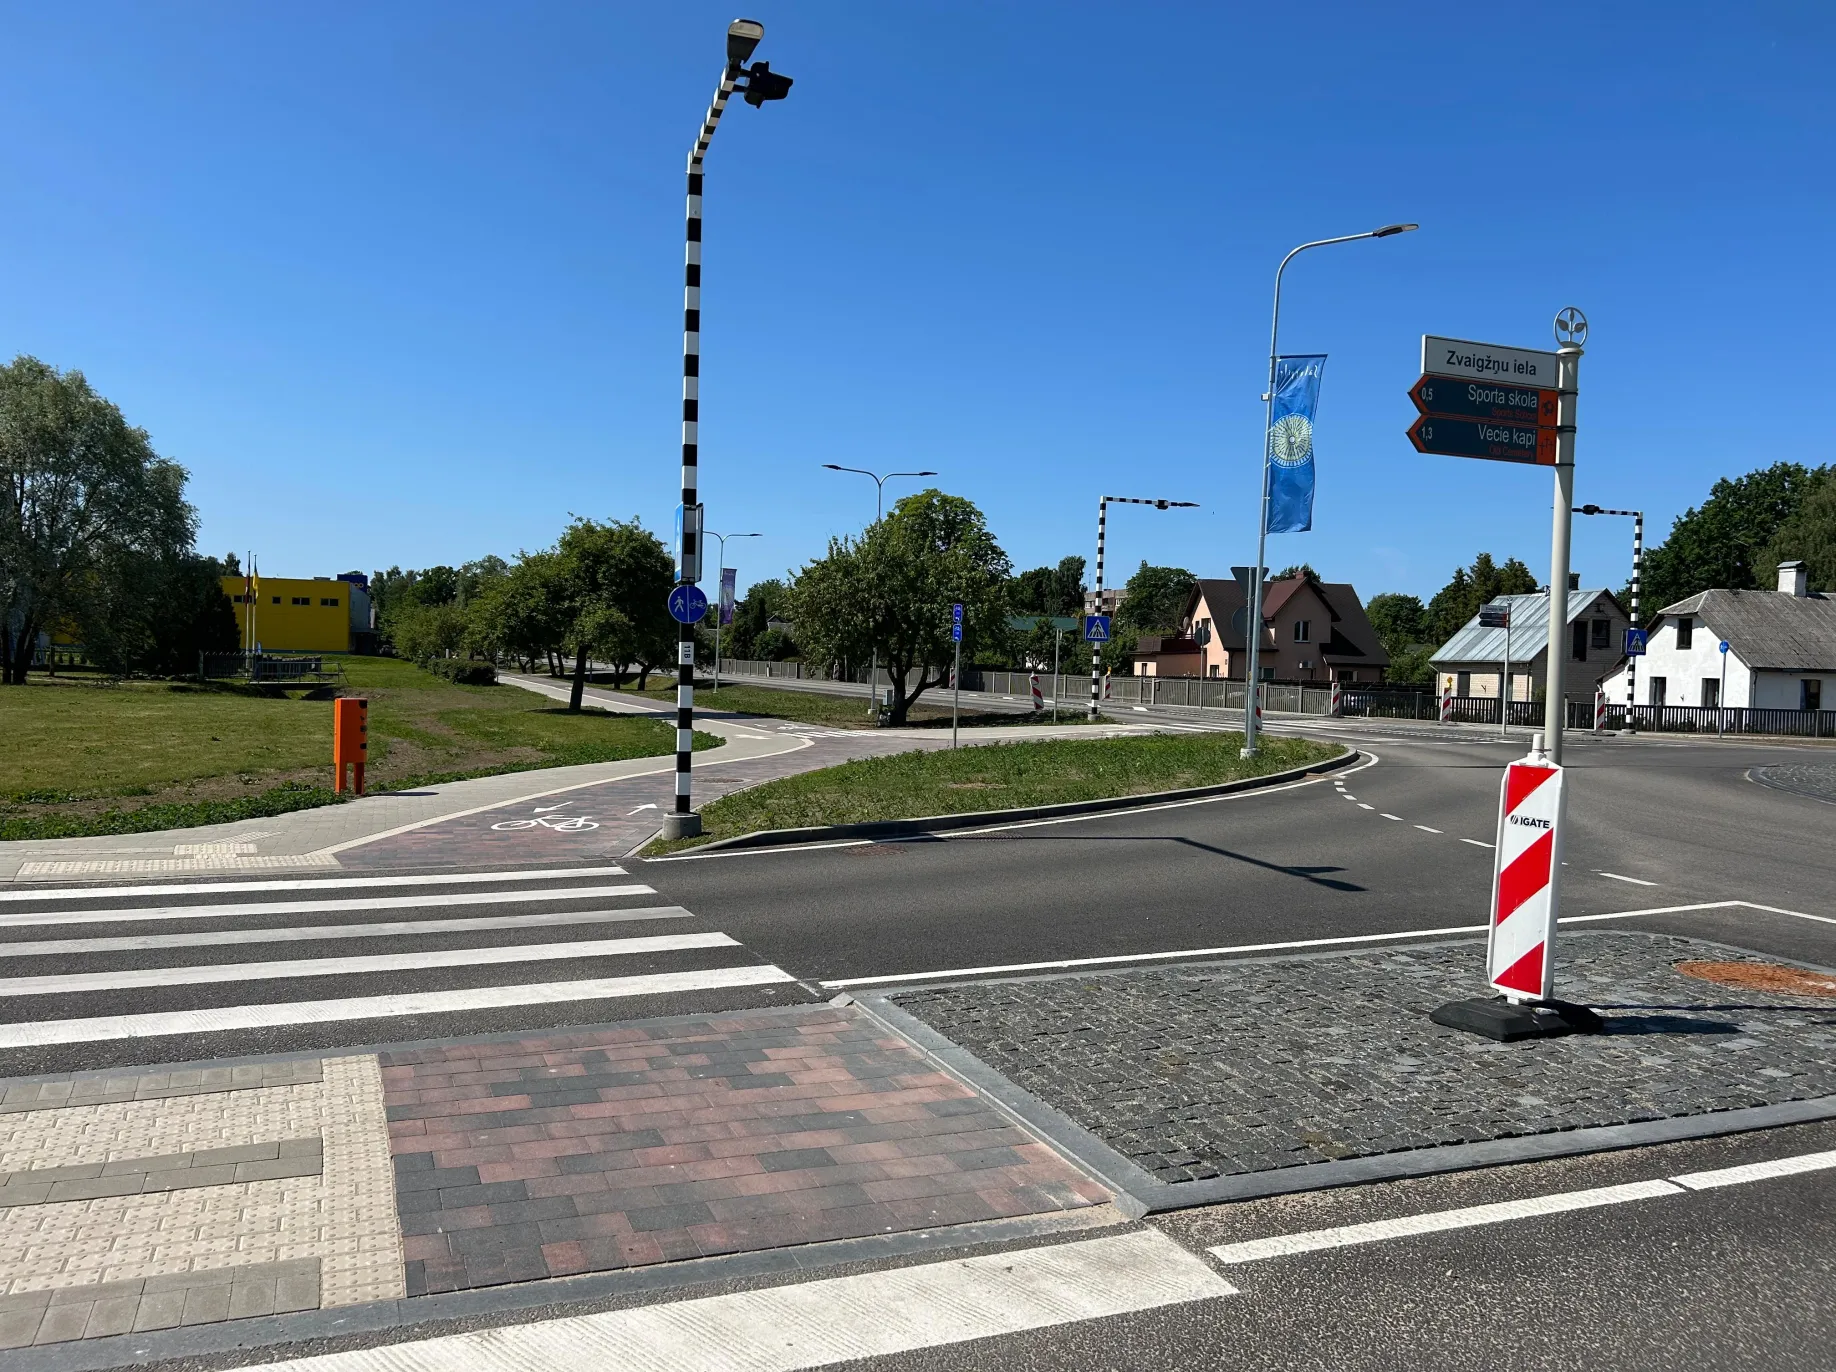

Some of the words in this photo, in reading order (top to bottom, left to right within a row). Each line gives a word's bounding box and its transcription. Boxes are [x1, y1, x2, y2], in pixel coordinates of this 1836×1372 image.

[1446, 350, 1509, 374] Zvaigžņu
[1513, 359, 1537, 376] iela
[1421, 387, 1433, 401] 0,5
[1468, 384, 1505, 404] Sporta
[1508, 390, 1537, 408] skola
[1421, 426, 1433, 440] 1,3
[1477, 423, 1509, 442] Vecie
[1512, 428, 1536, 448] kapi
[1520, 816, 1550, 828] IGATE
